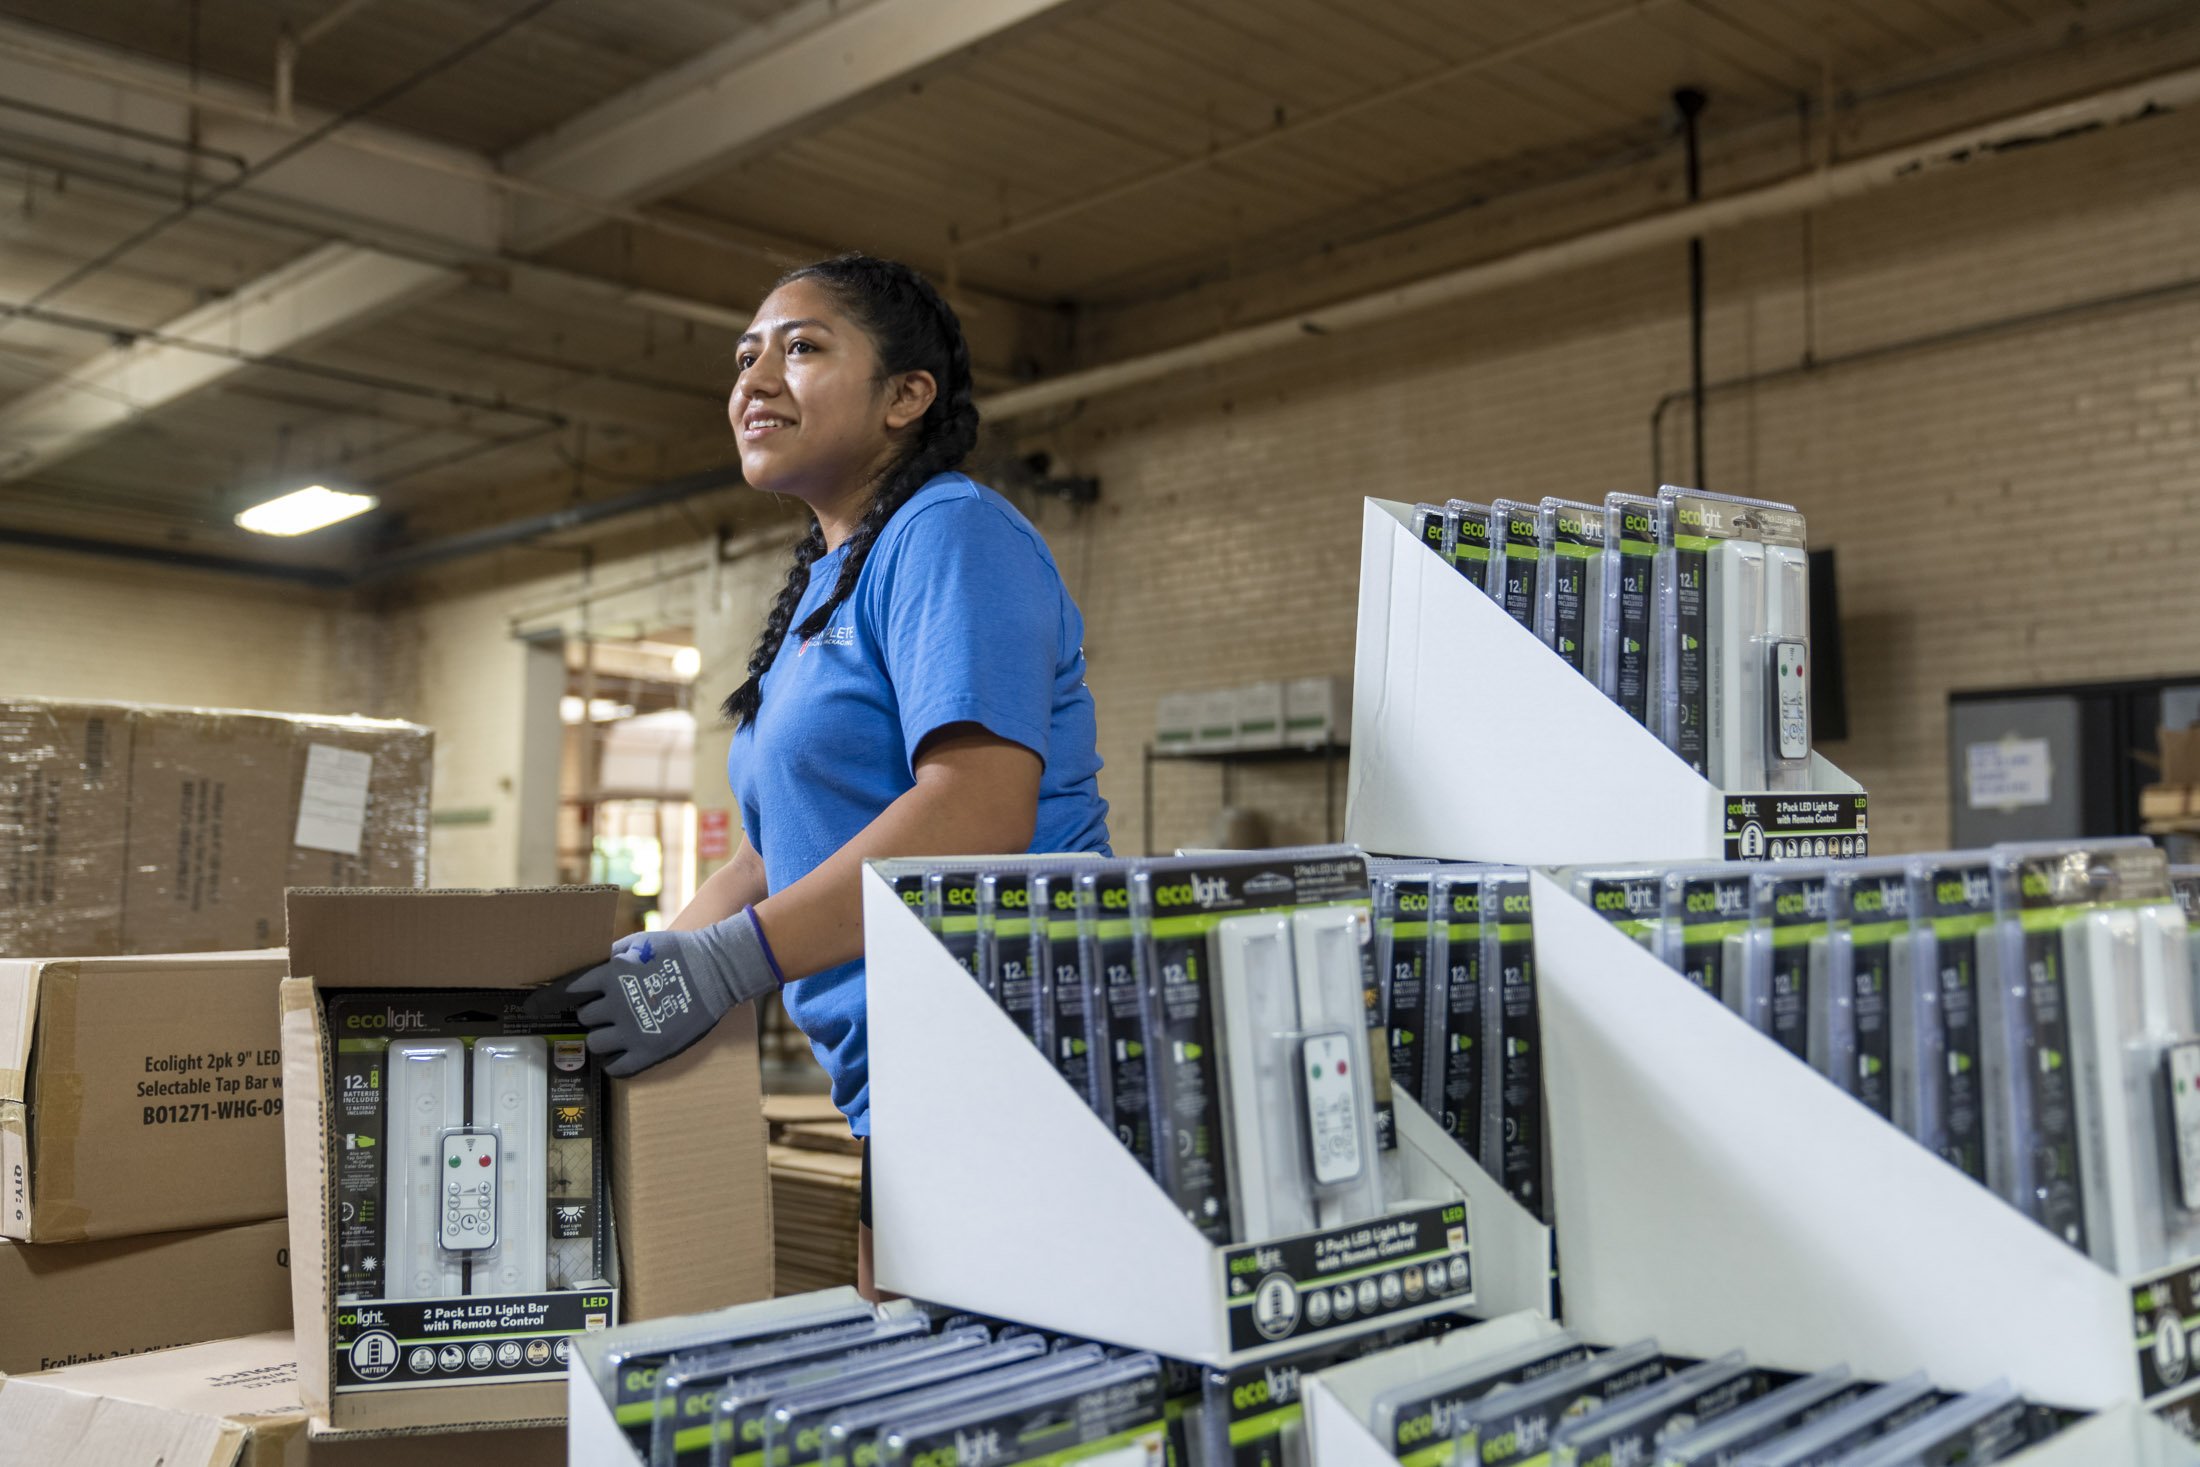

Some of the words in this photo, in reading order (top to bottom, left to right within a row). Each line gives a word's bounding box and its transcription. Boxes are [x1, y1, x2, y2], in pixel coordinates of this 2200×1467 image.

[1559, 513, 1603, 540] ecolight
[1728, 798, 1757, 817] ecolight
[1776, 803, 1782, 812] 2
[1783, 802, 1798, 812] Pack
[1799, 801, 1811, 811] LED
[1813, 801, 1827, 813] Light
[1828, 801, 1839, 811] Bar
[1854, 798, 1867, 808] LED
[1776, 814, 1791, 825] with
[1792, 814, 1815, 824] Remote
[1815, 813, 1837, 823] Control
[1155, 872, 1229, 908] ecolight
[623, 979, 654, 1029] IRON-TEK
[346, 1006, 424, 1032] ecolight
[145, 1051, 203, 1075] Ecolight
[207, 1052, 233, 1072] 2pk
[237, 1050, 252, 1067] 9"
[256, 1050, 281, 1066] LED
[137, 1079, 211, 1097] Selectable
[215, 1077, 240, 1095] Tap
[245, 1075, 268, 1090] Bar
[344, 1074, 368, 1089] 12x
[14, 1164, 24, 1204] QTY:
[15, 1209, 24, 1221] 6
[1442, 1206, 1465, 1223] LED
[1352, 1229, 1372, 1248] LED
[1380, 1237, 1416, 1257] Control
[423, 1309, 432, 1320] 2
[435, 1307, 465, 1319] Pack
[468, 1305, 492, 1317] LED
[495, 1304, 525, 1316] Light
[527, 1303, 549, 1314] Bar
[582, 1296, 609, 1308] LED
[338, 1307, 385, 1327] colight
[423, 1320, 450, 1332] with
[452, 1318, 497, 1330] Remote
[500, 1315, 544, 1328] Control
[360, 1366, 389, 1375] BATTERY
